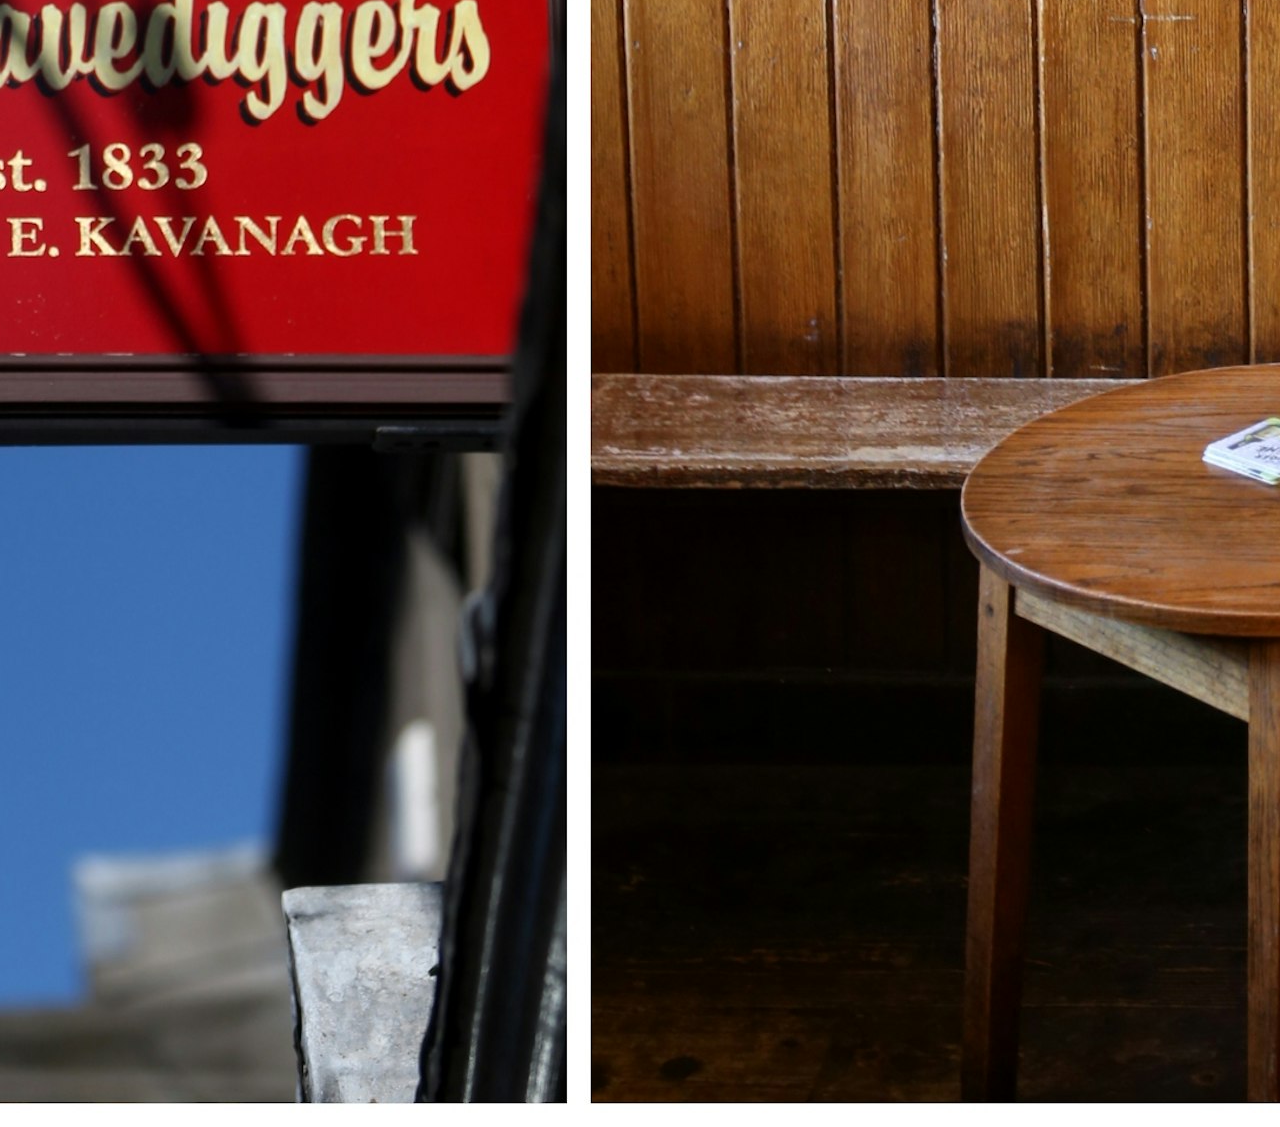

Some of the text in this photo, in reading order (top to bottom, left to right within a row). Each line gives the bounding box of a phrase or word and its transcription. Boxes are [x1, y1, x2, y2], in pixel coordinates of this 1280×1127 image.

[71, 142, 209, 191] 1833
[7, 218, 61, 258] E.
[74, 213, 419, 258] KAVANAGH
